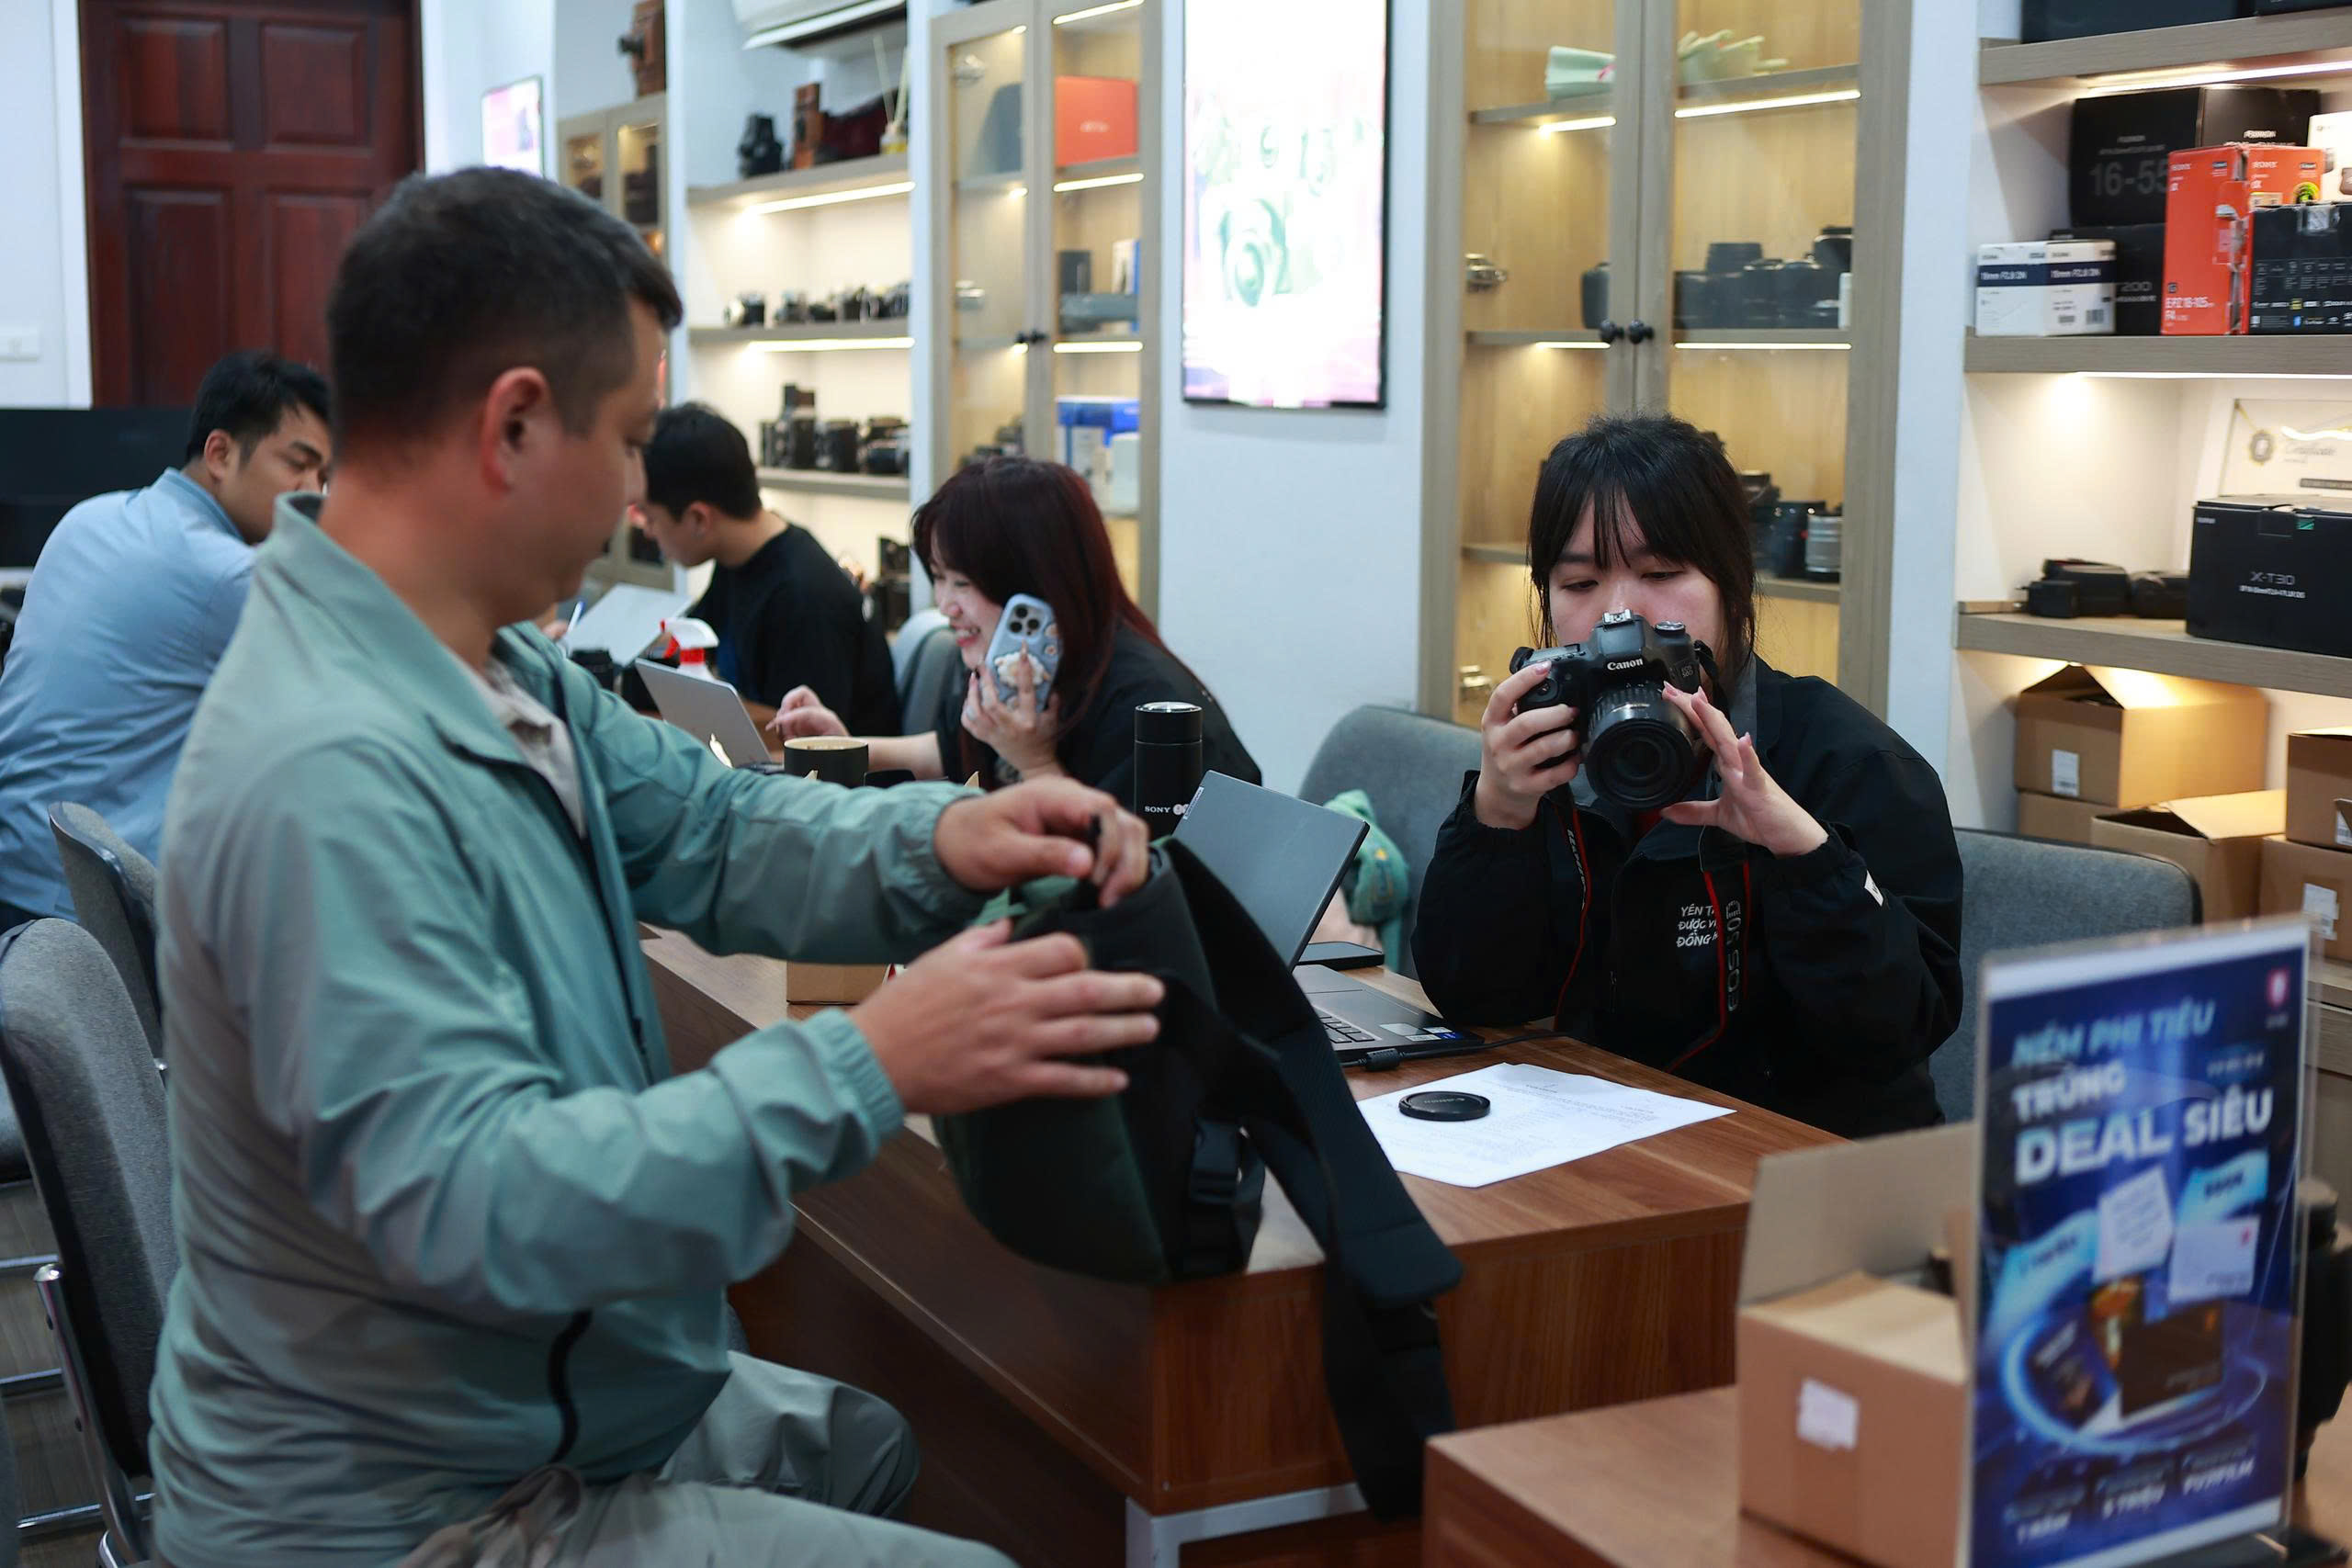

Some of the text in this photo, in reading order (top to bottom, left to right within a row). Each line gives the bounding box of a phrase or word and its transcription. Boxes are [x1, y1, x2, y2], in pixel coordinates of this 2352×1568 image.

[2250, 571, 2296, 586] X-T30
[1606, 658, 1644, 671] Canon
[2015, 1085, 2275, 1185] DEAL SIÊU
